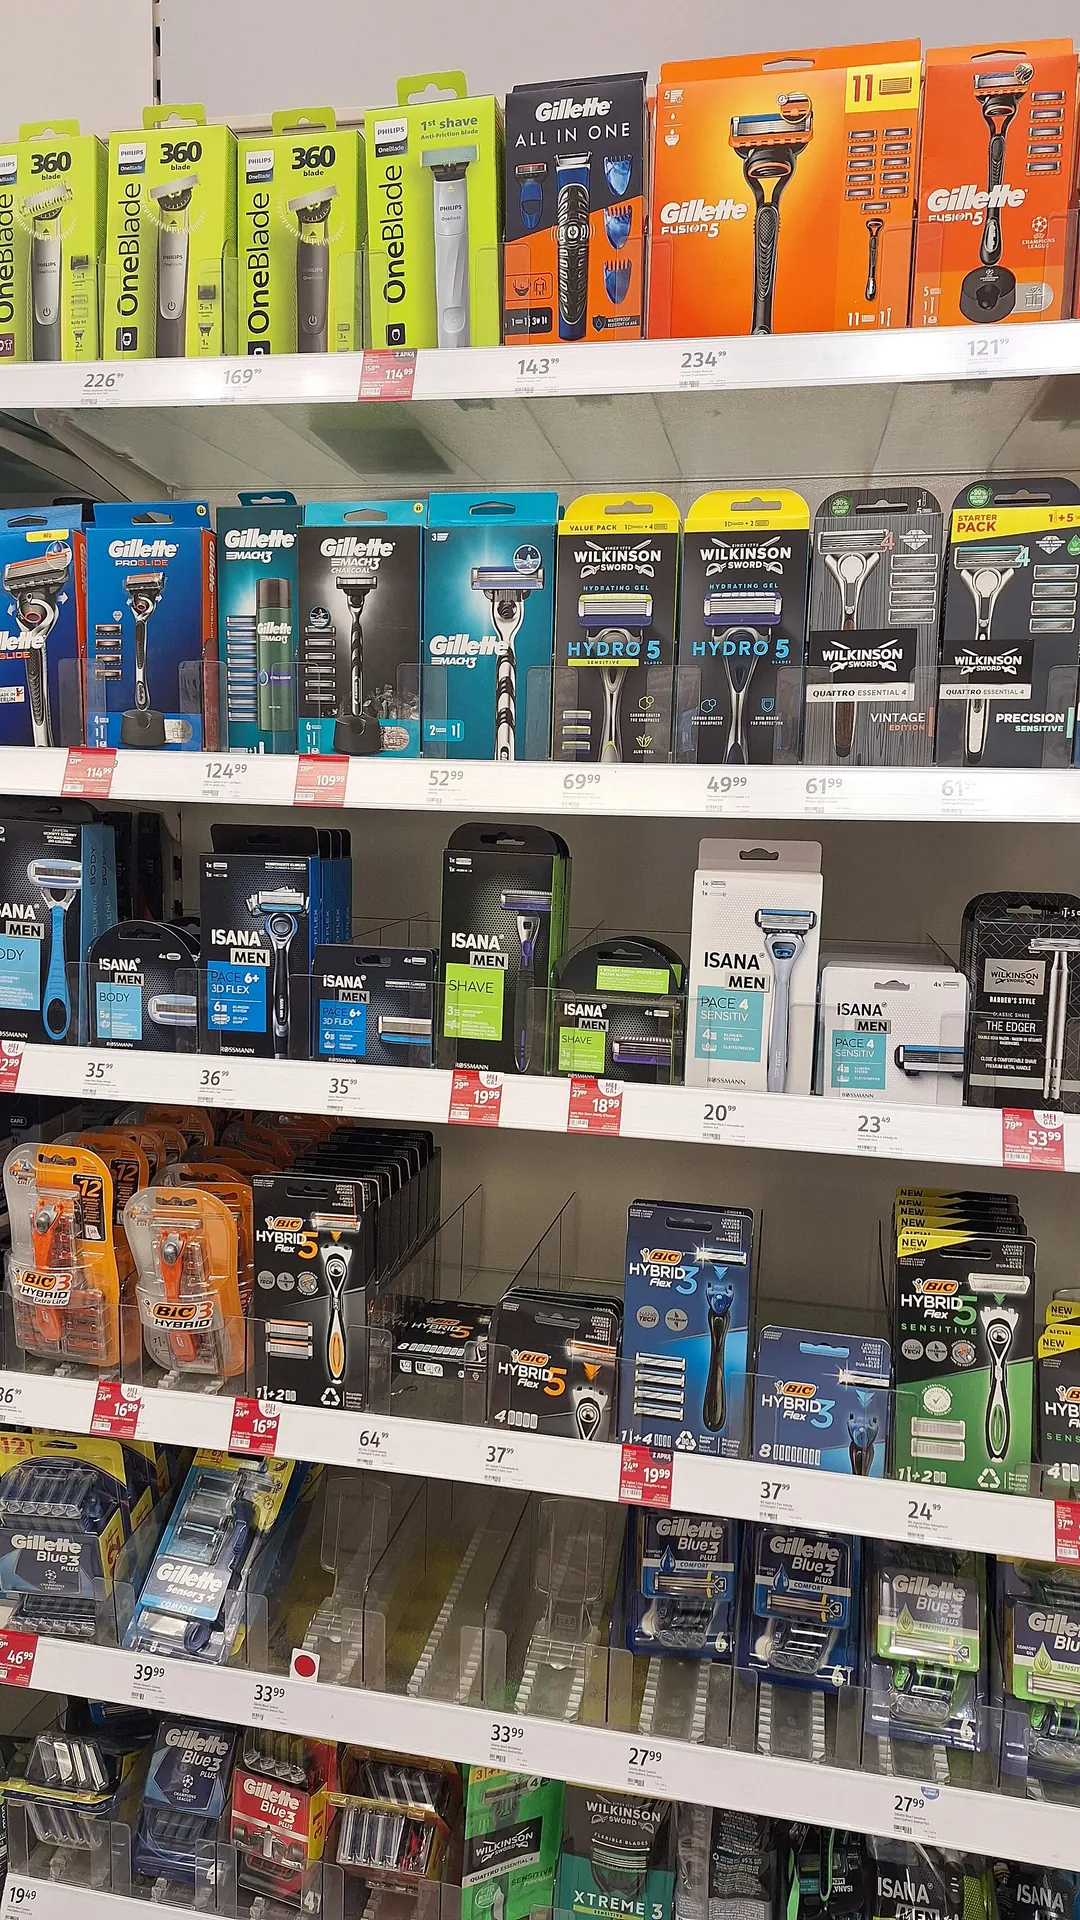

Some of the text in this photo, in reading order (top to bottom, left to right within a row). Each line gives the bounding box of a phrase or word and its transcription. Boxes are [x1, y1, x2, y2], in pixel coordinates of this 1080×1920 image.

[852, 74, 873, 102] 11
[535, 97, 610, 121] Gillette
[421, 116, 478, 131] 1st shave
[377, 126, 405, 135] PHILIPS
[421, 131, 459, 140] Anti-Friction
[515, 123, 630, 148] ALL IN ONE
[120, 149, 144, 158] PHILIPS
[159, 141, 202, 164] 360
[378, 145, 404, 153] OneBlade
[30, 151, 71, 174] 360
[248, 157, 271, 165] PHILIPS
[291, 145, 335, 169] 360
[120, 164, 143, 172] OneBlade
[303, 169, 324, 177] blade
[42, 173, 61, 181] blade
[927, 185, 1026, 212] Gillette
[660, 199, 747, 224] Gillette
[379, 165, 406, 303] OneBlade
[1022, 237, 1056, 246] CHAMPIONS
[118, 183, 141, 316] OneBlade
[246, 192, 270, 334] OneBlade
[957, 521, 997, 533] PACK
[225, 528, 295, 549] Gillette
[108, 539, 177, 558] Gillette
[320, 536, 394, 558] Gillette
[574, 550, 662, 563] WILKINSON
[700, 547, 792, 561] WILKINSON
[601, 563, 633, 571] SWORD
[728, 561, 762, 569] SWORD
[257, 622, 292, 635] Gillette
[429, 634, 509, 656] Gillette
[568, 640, 661, 659] HYDRO 5
[692, 639, 789, 658] HYDRO 5
[822, 649, 903, 662] WILKINSON
[955, 655, 1022, 666] WILKINSON
[901, 688, 907, 696] 4
[871, 713, 925, 722] VINTAGE
[996, 713, 1065, 723] PRECISION
[211, 930, 261, 946] ISANA
[451, 933, 500, 950] ISANA
[234, 952, 266, 963] MEN
[473, 954, 505, 968] MEN
[704, 952, 759, 970] ISANA
[100, 958, 137, 971] ISANA
[117, 973, 142, 984] MEN
[211, 971, 259, 984] PACE 6+
[323, 975, 362, 989] ISANA
[991, 971, 1038, 980] WILKINSON
[211, 984, 250, 994] 3D FLEX
[449, 980, 494, 994] SHAVE
[728, 976, 765, 990] MEN
[100, 993, 130, 1003] BODY
[342, 992, 367, 1002] MEN
[701, 997, 748, 1010] PACE 4
[990, 996, 1016, 1004] BARBER'S
[322, 1008, 361, 1017] PACE 6+
[564, 1004, 602, 1018] ISANA
[701, 1010, 748, 1022] SENSITIV
[837, 1003, 882, 1017] ISANA
[335, 1018, 353, 1026] FLEX
[581, 1019, 606, 1030] MEN
[857, 1021, 888, 1032] MEN
[986, 1021, 1036, 1033] THE EDGER
[561, 1035, 592, 1045] SHAVE
[835, 1038, 874, 1048] PACE 4
[835, 1049, 874, 1058] SENSITIV
[79, 1179, 103, 1197] 12
[256, 1230, 319, 1260] HYBRID 5
[274, 1244, 295, 1254] Flex
[901, 1238, 927, 1248] NEW
[651, 1252, 679, 1263] BIC
[629, 1263, 699, 1295] HYBRID 3
[649, 1278, 672, 1289] Flex
[21, 1285, 68, 1300] HYBRID
[923, 1309, 948, 1319] Flex
[901, 1323, 977, 1335] SENSITIVE
[656, 1518, 724, 1539] Gillette
[10, 1534, 82, 1554] Gillette
[769, 1536, 840, 1561] Gillette
[680, 1561, 709, 1569] COMFORT
[156, 1563, 223, 1592] Gillette
[794, 1582, 824, 1591] COMFORT
[892, 1575, 966, 1602] Gillette
[161, 1600, 197, 1614] COMFORT
[165, 1728, 229, 1755] Gillette
[243, 1778, 299, 1810] Gillette
[587, 1801, 661, 1823] WILKINSON
[594, 1832, 649, 1846] FLEXIBLE BLADES
[574, 1890, 663, 1920] XTREME 3
